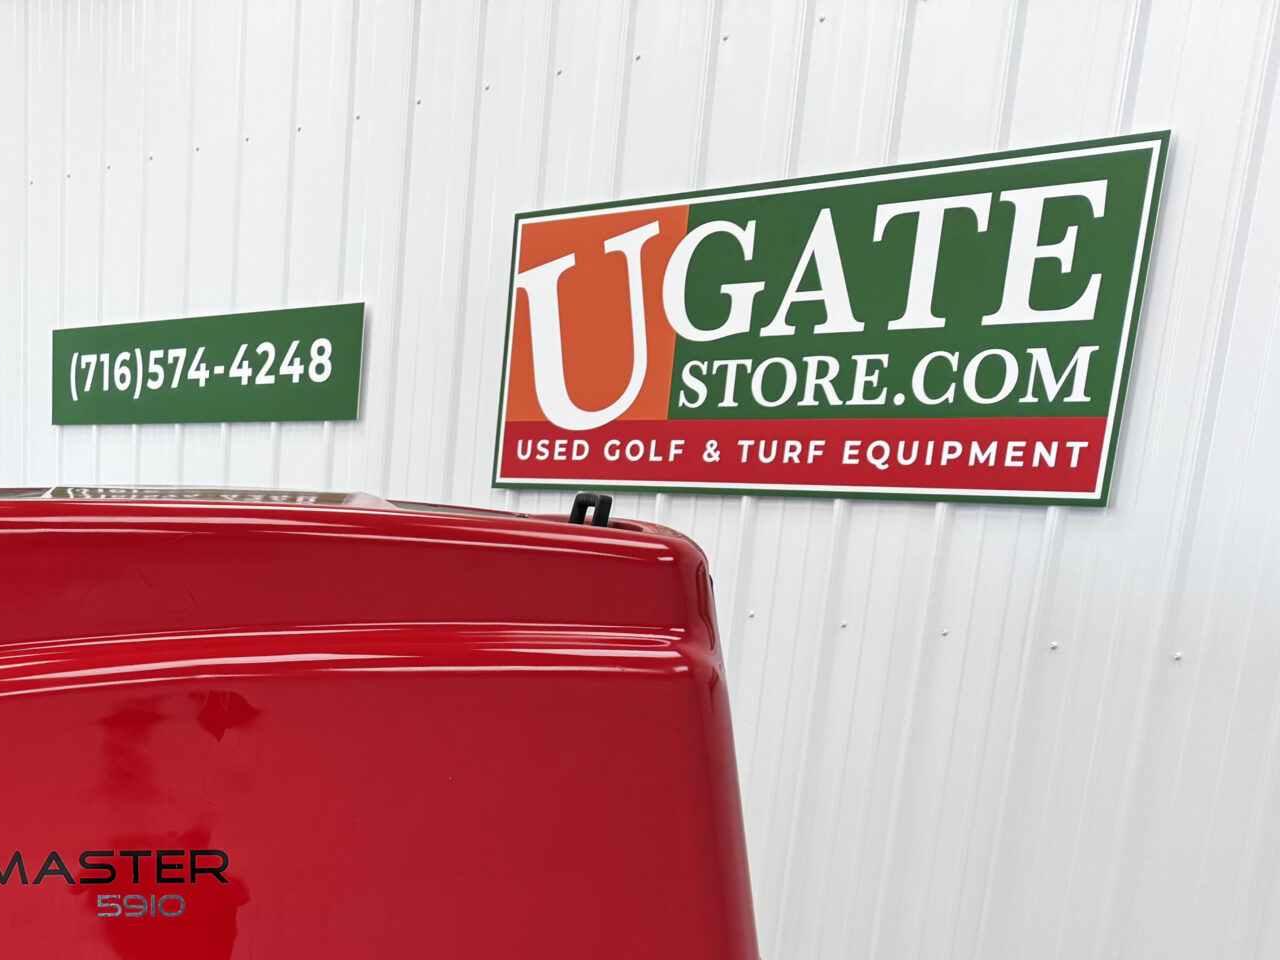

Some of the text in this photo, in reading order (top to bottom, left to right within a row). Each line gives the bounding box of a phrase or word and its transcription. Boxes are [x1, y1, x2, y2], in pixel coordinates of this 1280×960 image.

[70, 338, 333, 401] (716)574-4248
[678, 345, 1100, 408] STORE.COM
[516, 439, 1089, 469] USED GOLF & TURF EQUIPMENT
[96, 894, 186, 918] 5910
